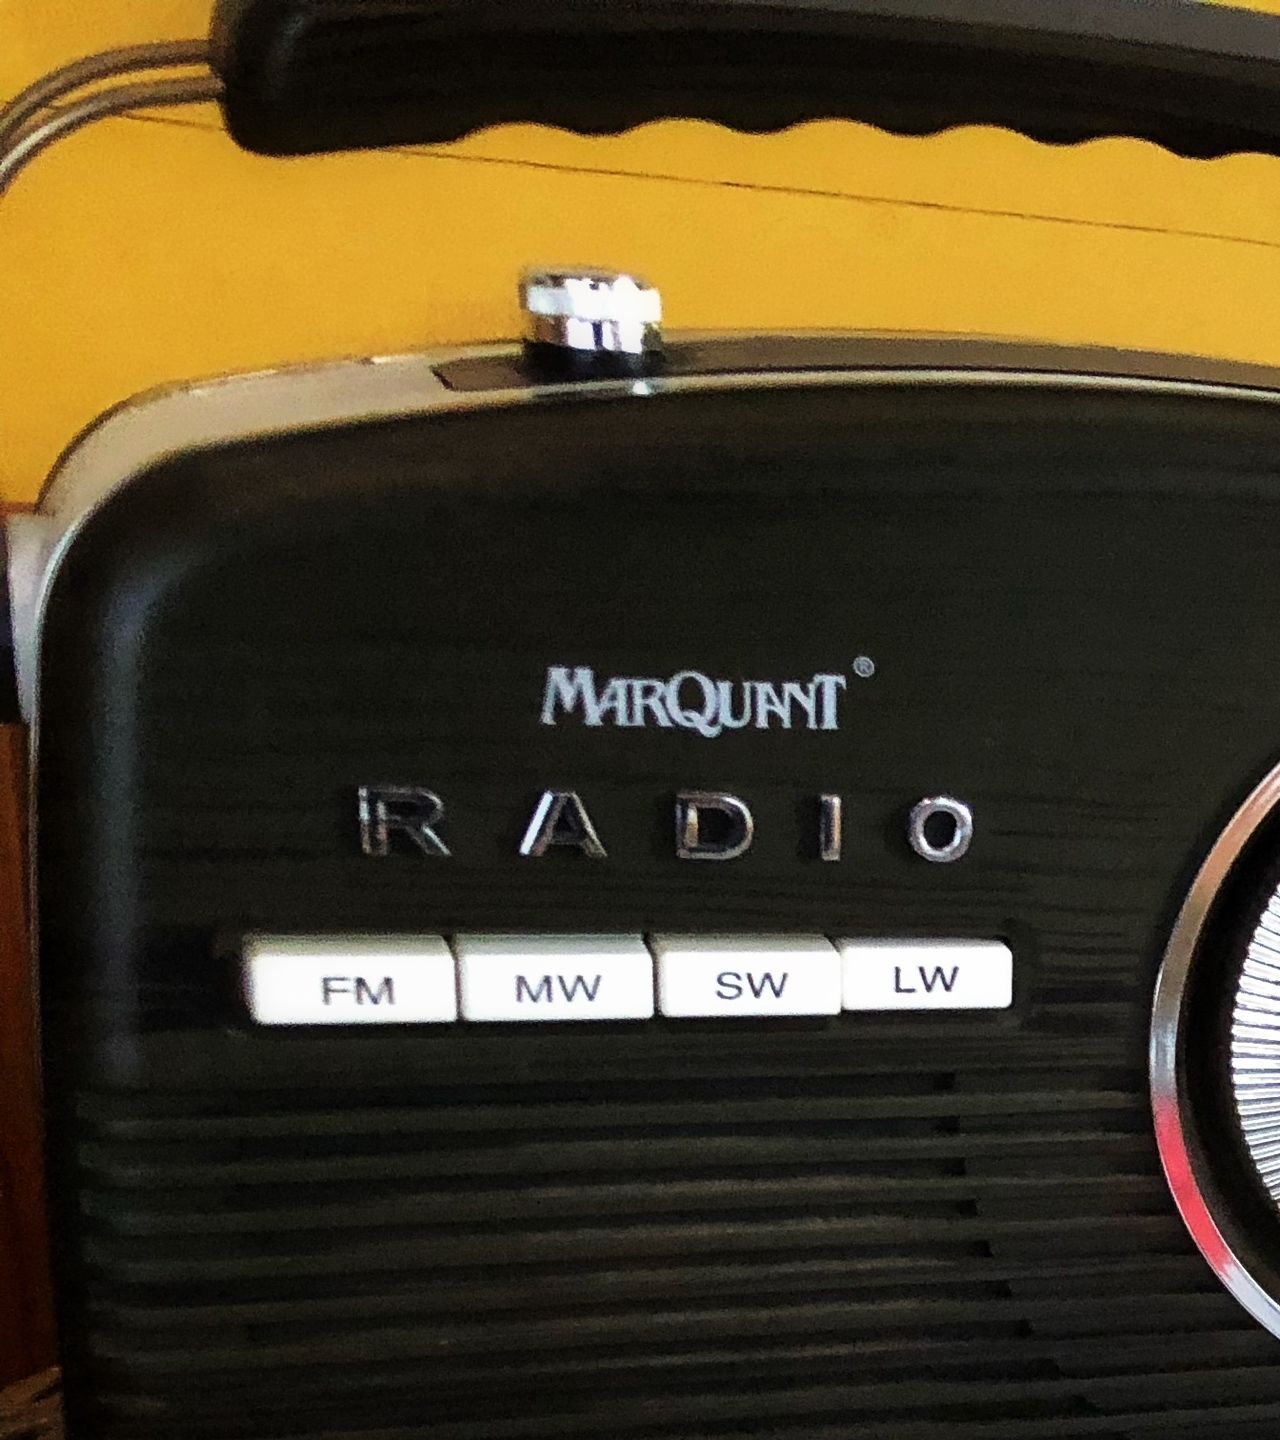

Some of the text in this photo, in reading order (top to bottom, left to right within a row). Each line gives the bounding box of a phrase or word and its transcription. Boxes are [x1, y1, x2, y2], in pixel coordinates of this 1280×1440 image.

[356, 784, 975, 862] RADIO
[322, 975, 396, 1006] FM
[514, 973, 602, 1004] MW
[715, 971, 788, 1001] SW
[893, 965, 960, 995] LW
